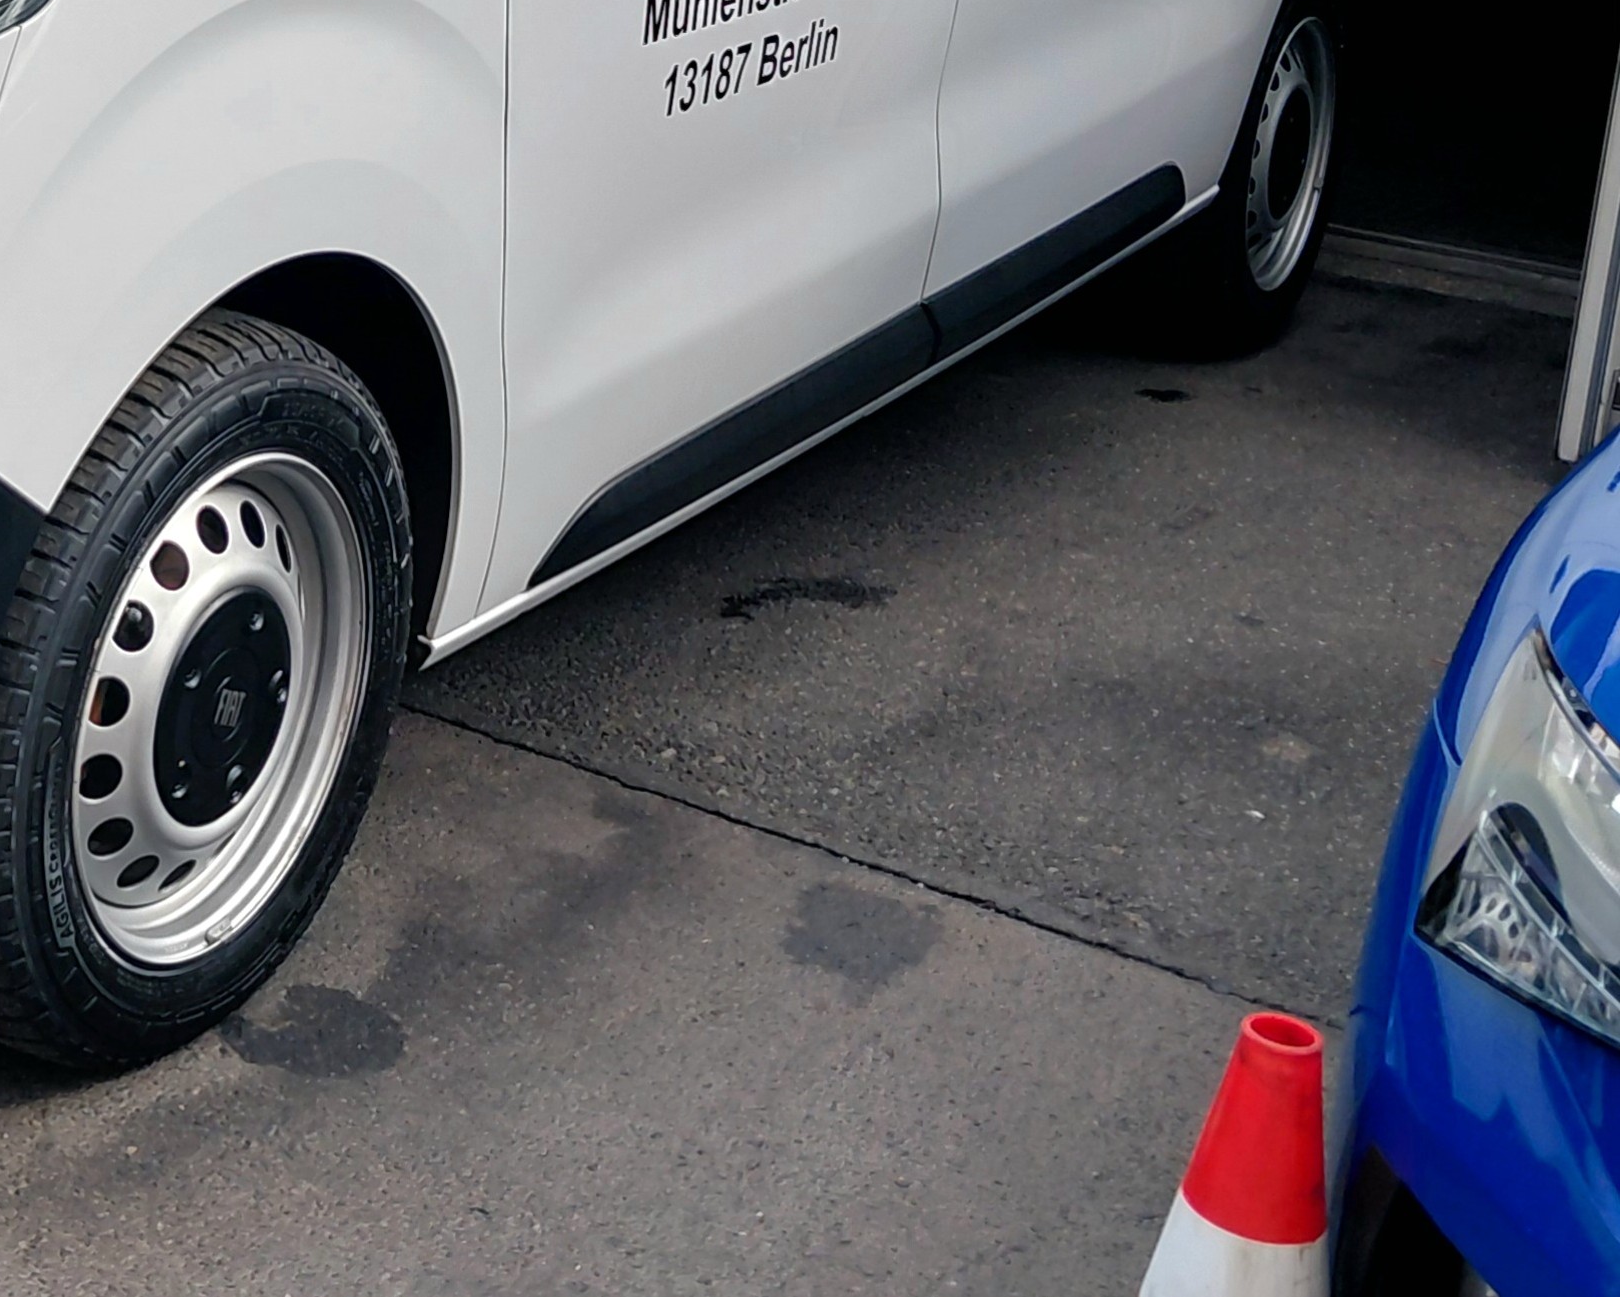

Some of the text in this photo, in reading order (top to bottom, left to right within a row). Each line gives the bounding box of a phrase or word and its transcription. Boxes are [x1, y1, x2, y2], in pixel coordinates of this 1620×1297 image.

[664, 18, 840, 117] 13187 Berlin
[49, 875, 75, 940] AGILIS
